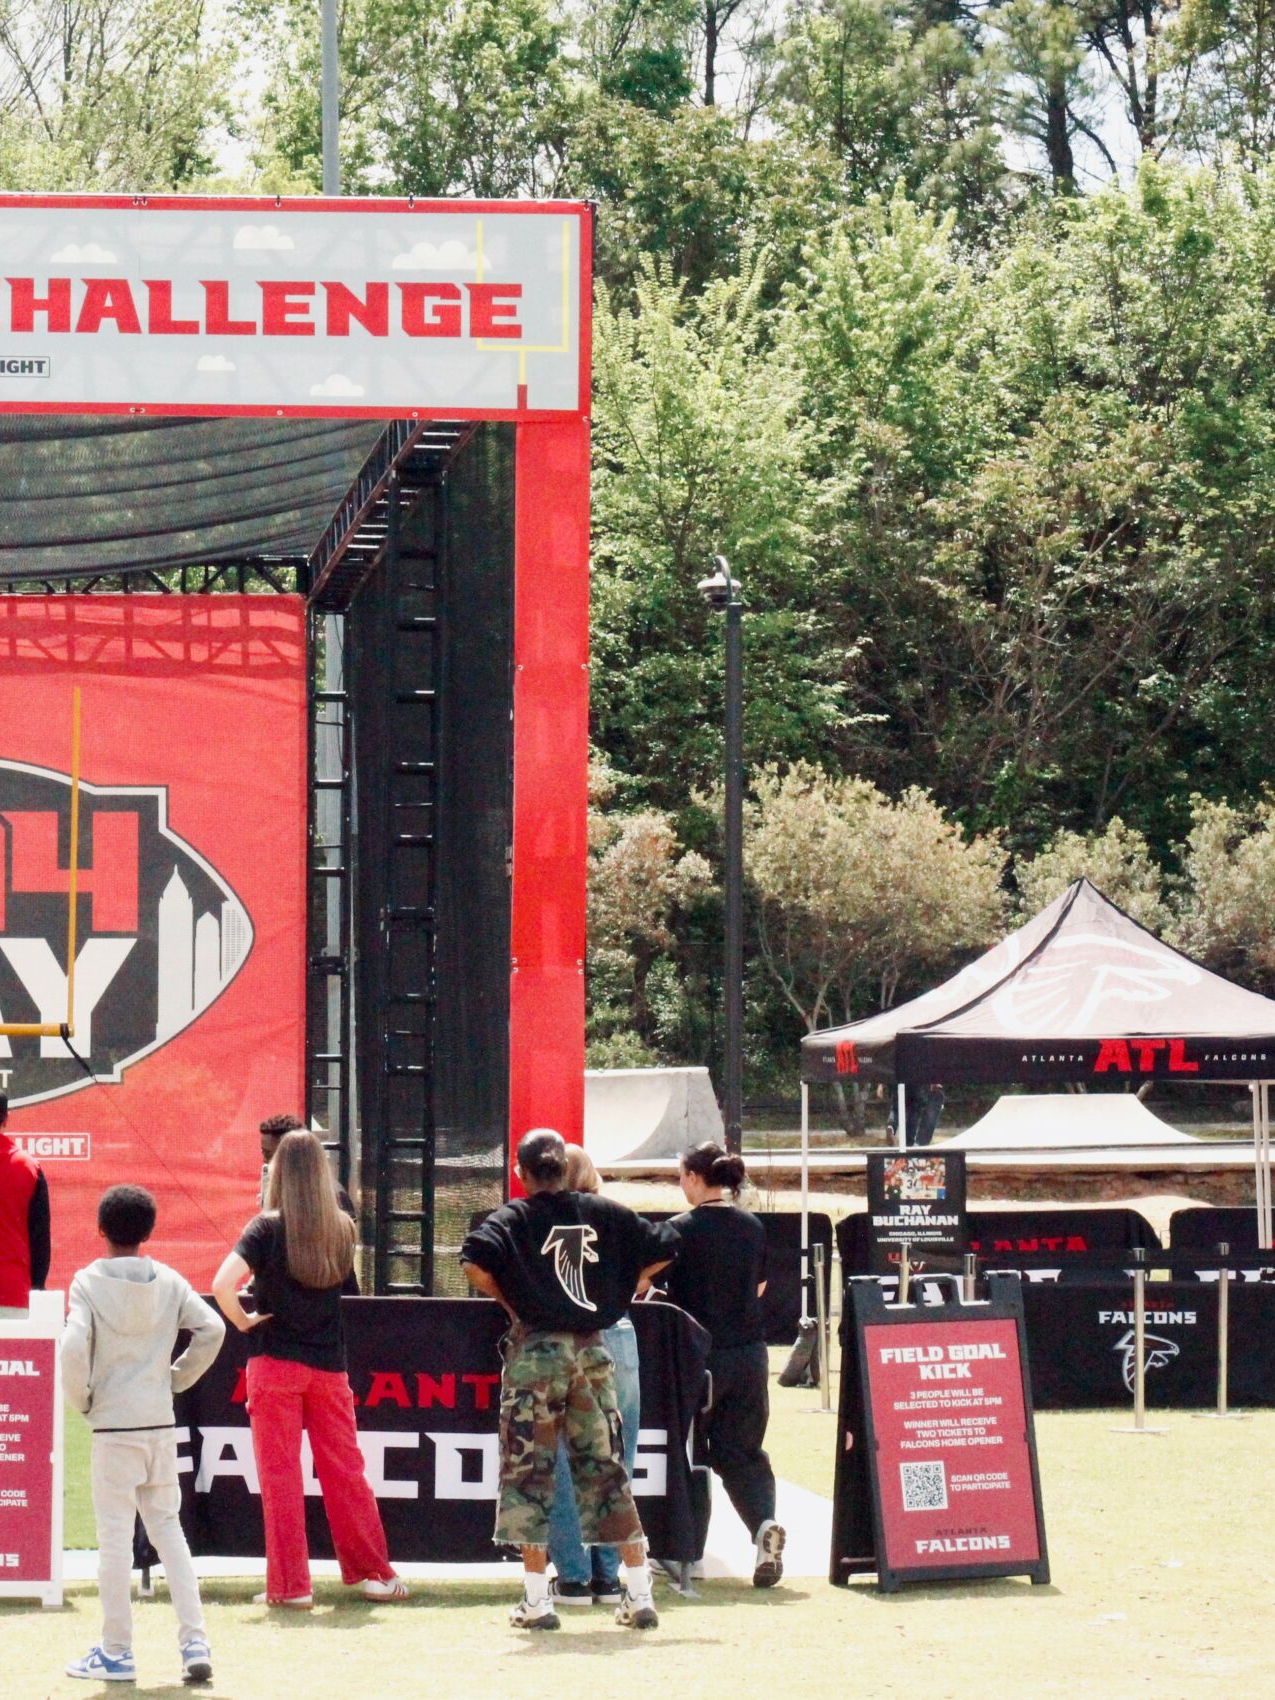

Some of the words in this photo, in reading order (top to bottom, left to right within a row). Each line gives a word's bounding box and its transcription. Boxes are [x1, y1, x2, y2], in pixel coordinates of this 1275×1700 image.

[1022, 1054, 1084, 1062] ATLANTA
[1094, 1039, 1199, 1072] ATL
[1205, 1053, 1267, 1061] FALCONS
[899, 1204, 932, 1216] RAY
[872, 1214, 959, 1227] BUCHANAN
[879, 1346, 943, 1364] FIELD
[947, 1343, 1007, 1360] GOAL
[918, 1363, 972, 1380] KICK
[910, 1391, 916, 1399] 3
[916, 1390, 950, 1399] PEOPLE
[951, 1389, 971, 1397] WILL
[972, 1388, 984, 1396] BE
[893, 1401, 938, 1410] SELECTED
[939, 1399, 952, 1408] TO
[952, 1398, 973, 1407] KICK
[973, 1398, 983, 1406] AT
[904, 1420, 939, 1429] WINNER
[939, 1419, 959, 1428] WILL
[960, 1417, 997, 1426] RECEIVE
[916, 1430, 937, 1438] TWO
[937, 1428, 973, 1437] TICKETS
[974, 1427, 986, 1435] TO
[900, 1439, 941, 1449] FALCONS
[941, 1438, 967, 1447] HOME
[968, 1436, 1003, 1445] OPENER
[951, 1475, 973, 1483] SCAN
[985, 1472, 1008, 1480] CODE
[962, 1481, 1011, 1491] PARTICIPATE
[1, 1490, 26, 1498] CODE
[935, 1527, 987, 1536] ATLANTA
[915, 1536, 1011, 1554] FALCONS
